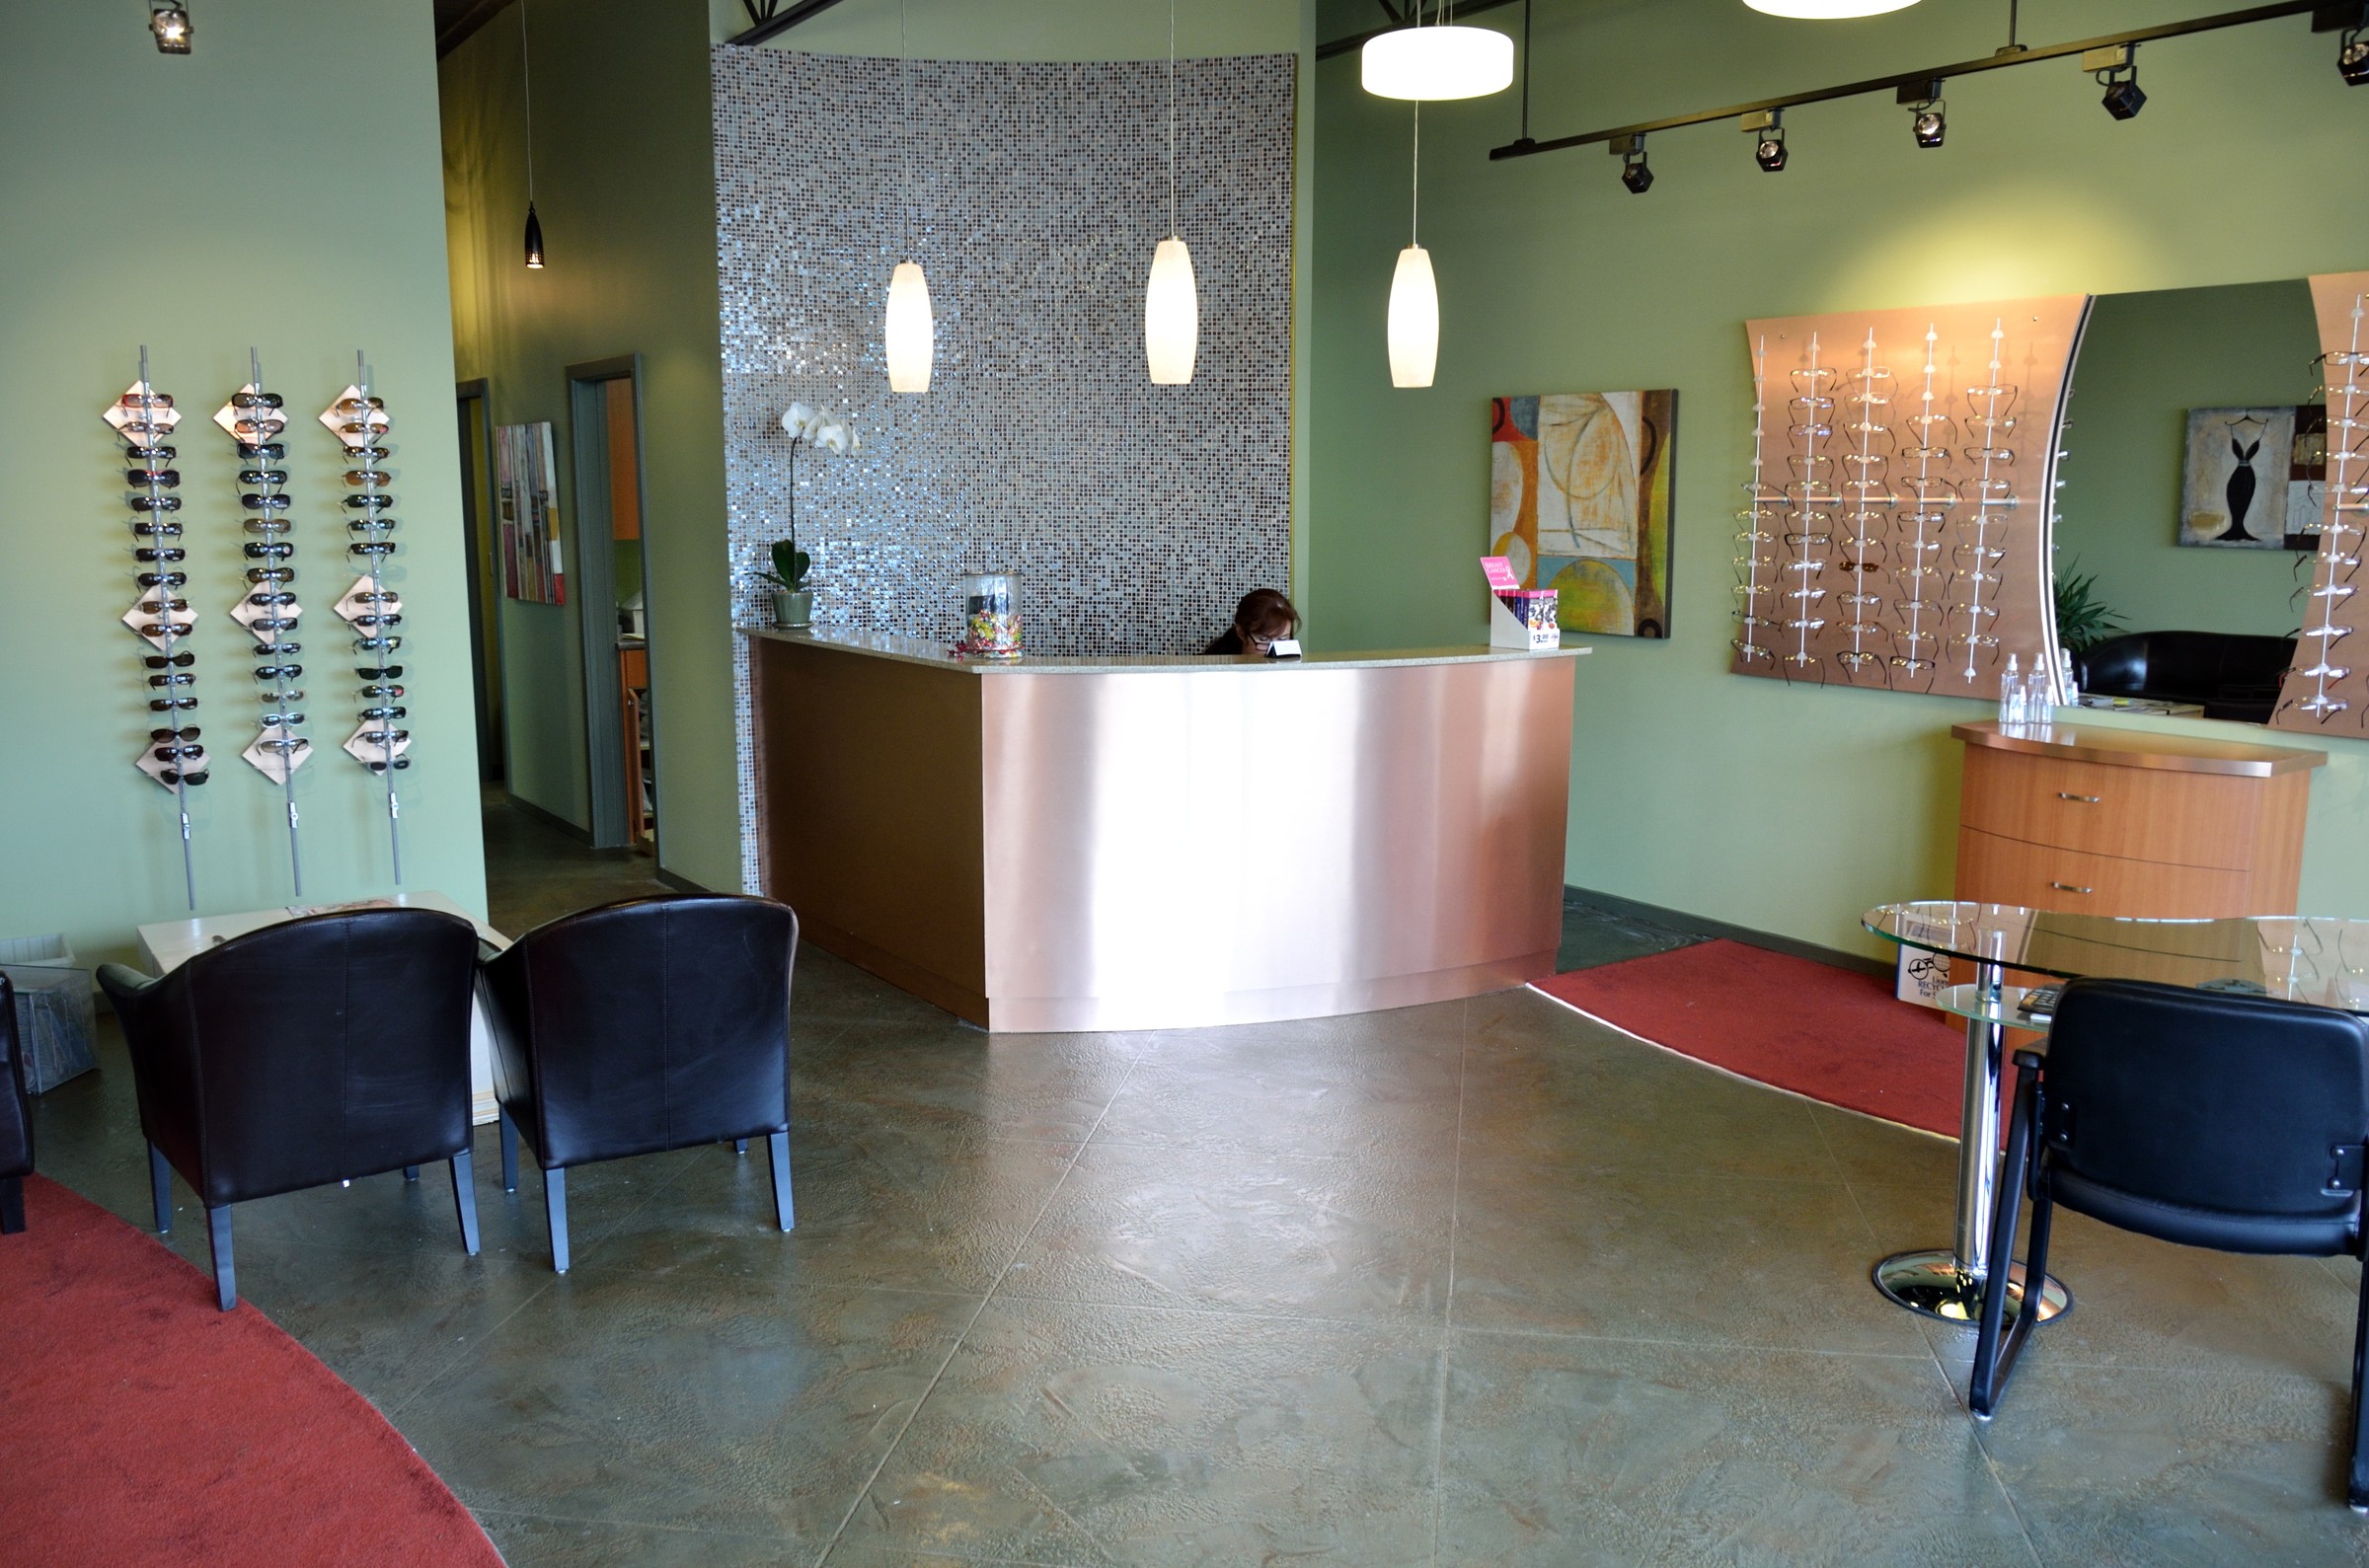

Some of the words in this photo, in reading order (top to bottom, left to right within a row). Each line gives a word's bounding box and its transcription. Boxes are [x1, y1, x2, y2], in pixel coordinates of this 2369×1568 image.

[1532, 634, 1549, 643] $3.00
[1932, 976, 1949, 986] Lion
[1920, 989, 1931, 998] For
